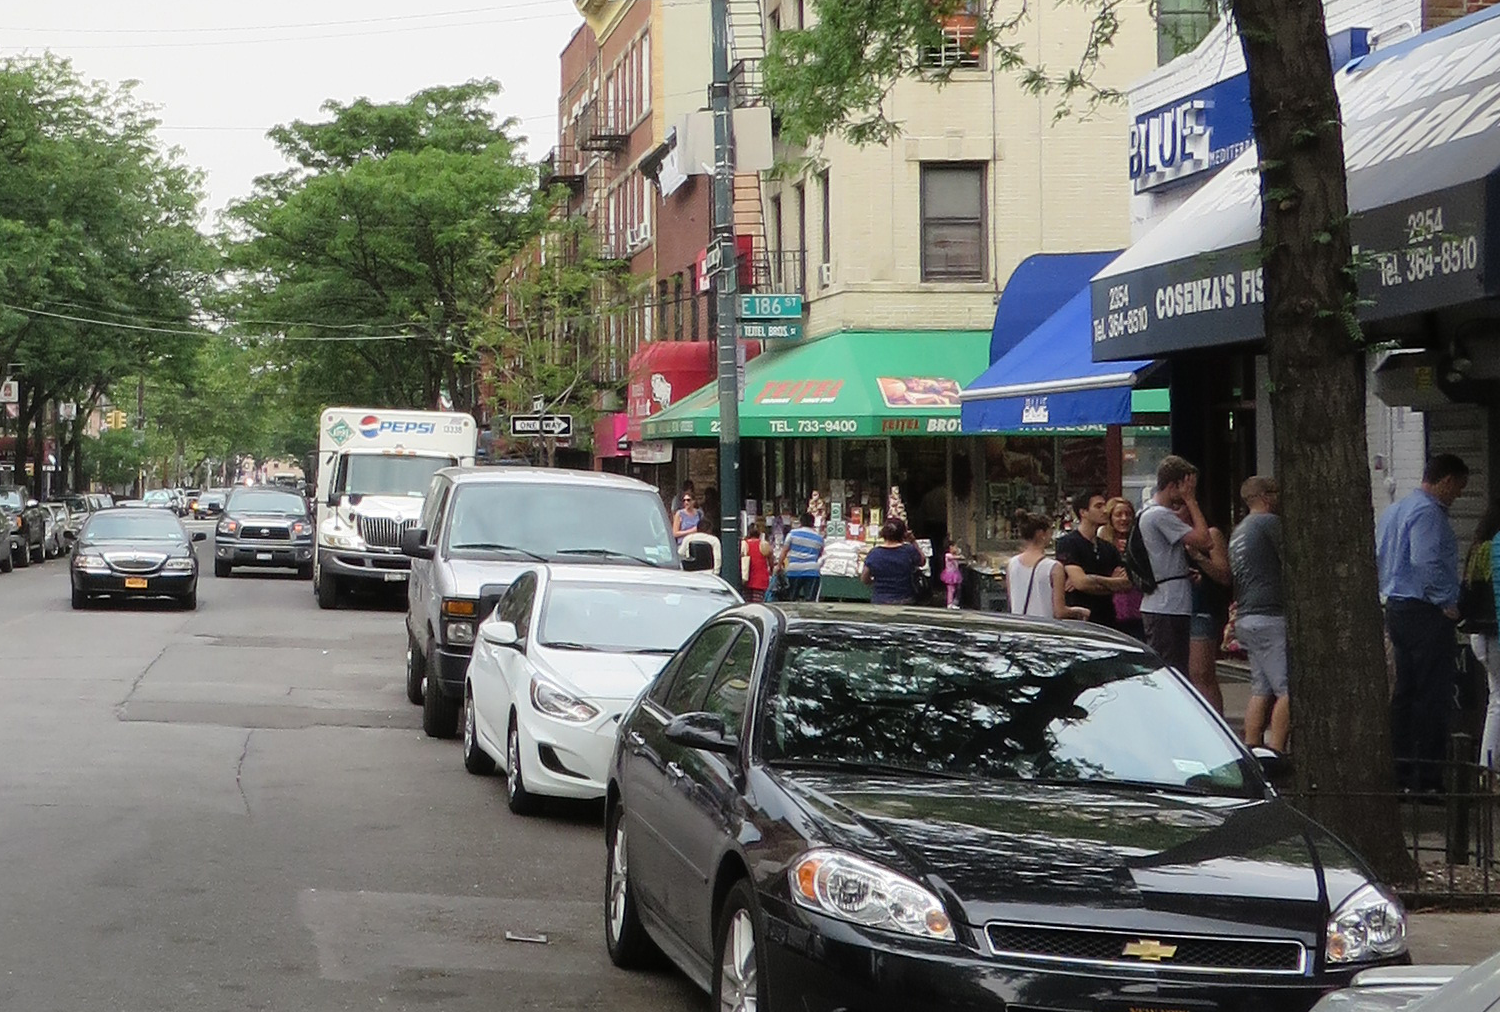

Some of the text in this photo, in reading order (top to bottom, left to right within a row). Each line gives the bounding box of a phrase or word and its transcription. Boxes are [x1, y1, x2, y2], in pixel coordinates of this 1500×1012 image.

[1129, 100, 1211, 180] BLUE
[1407, 206, 1443, 244] 2354
[1378, 235, 1477, 286] Tel. 364-8510
[742, 297, 797, 315] E 186 ST
[1155, 267, 1265, 320] COSENZA'S FIS
[1108, 305, 1149, 338] 364-8510
[378, 421, 436, 434] PEPSI
[520, 420, 561, 431] ONE WAY
[769, 420, 858, 432] TEL. 733-9400
